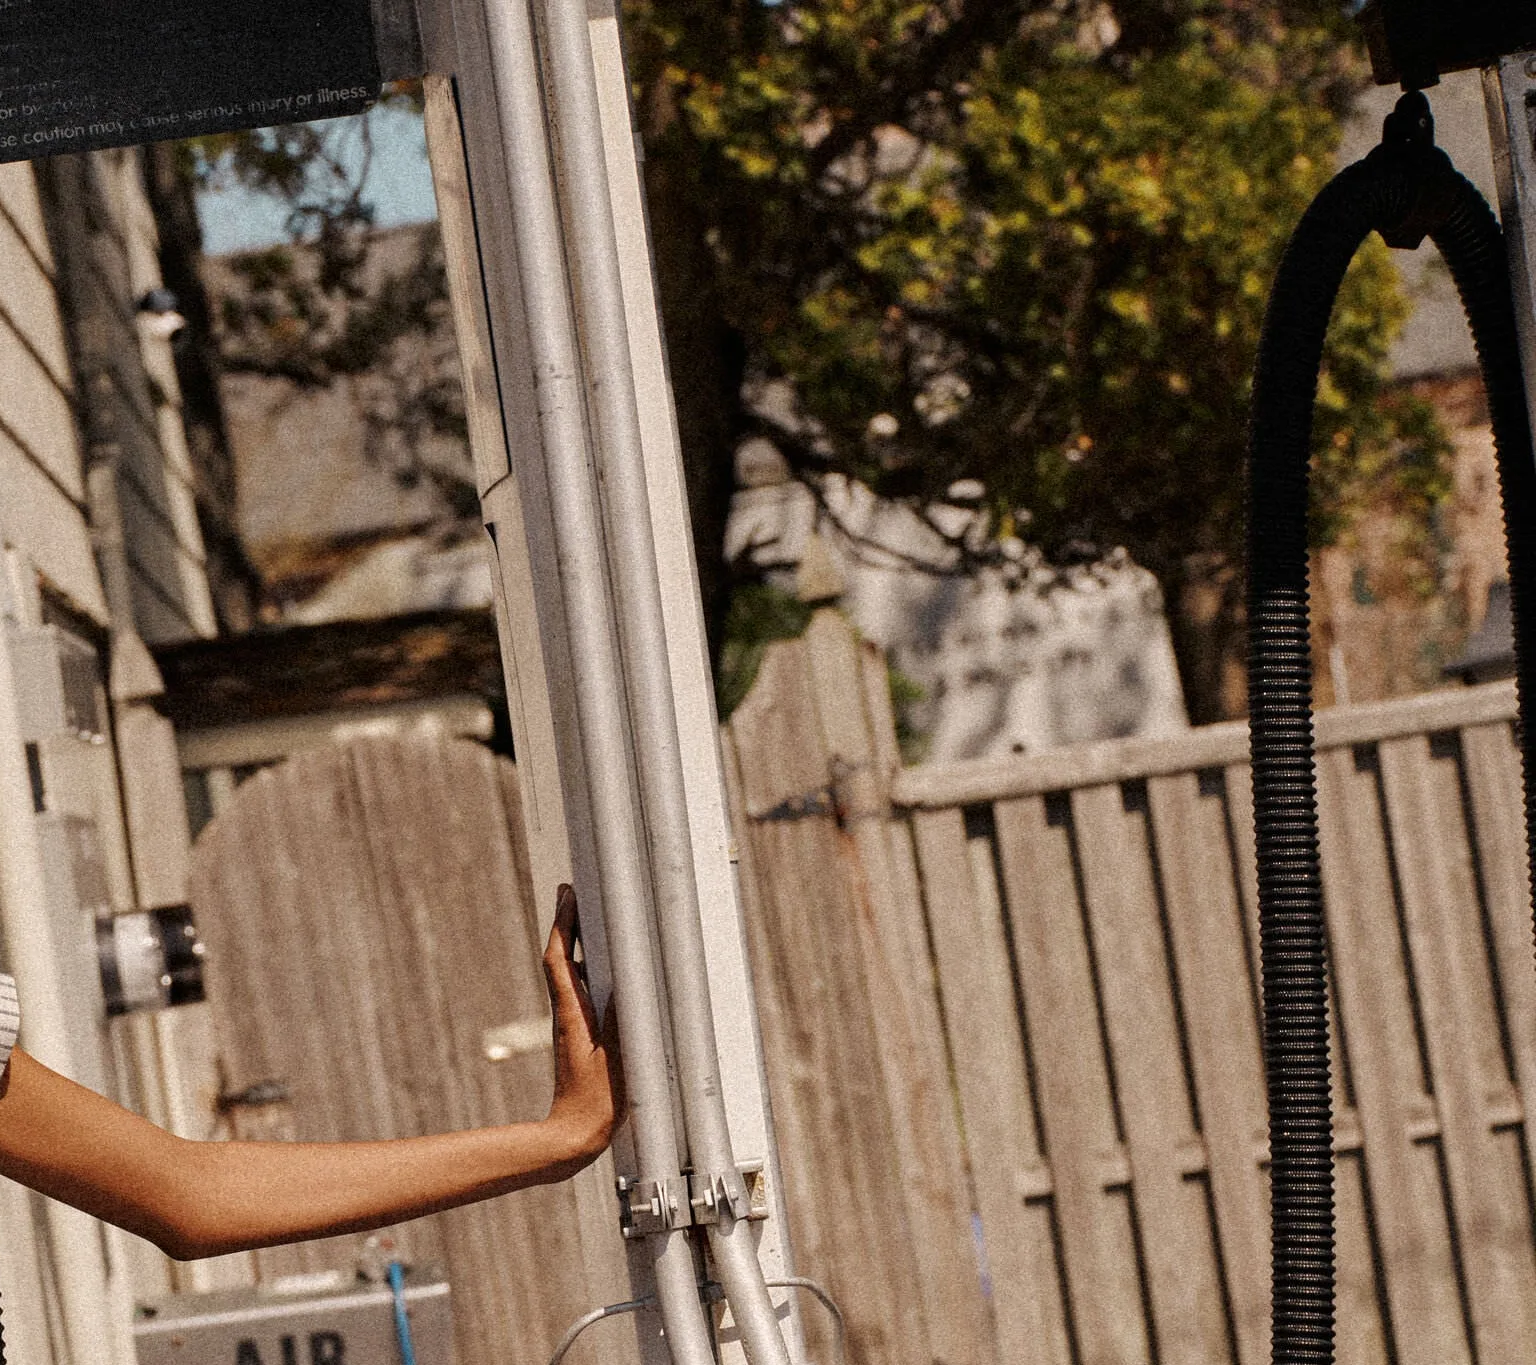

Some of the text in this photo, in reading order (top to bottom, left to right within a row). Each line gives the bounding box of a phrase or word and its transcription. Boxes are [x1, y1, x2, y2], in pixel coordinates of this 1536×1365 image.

[23, 126, 85, 144] caution
[89, 120, 124, 137] may
[295, 94, 313, 108] or
[317, 84, 370, 104] illness.
